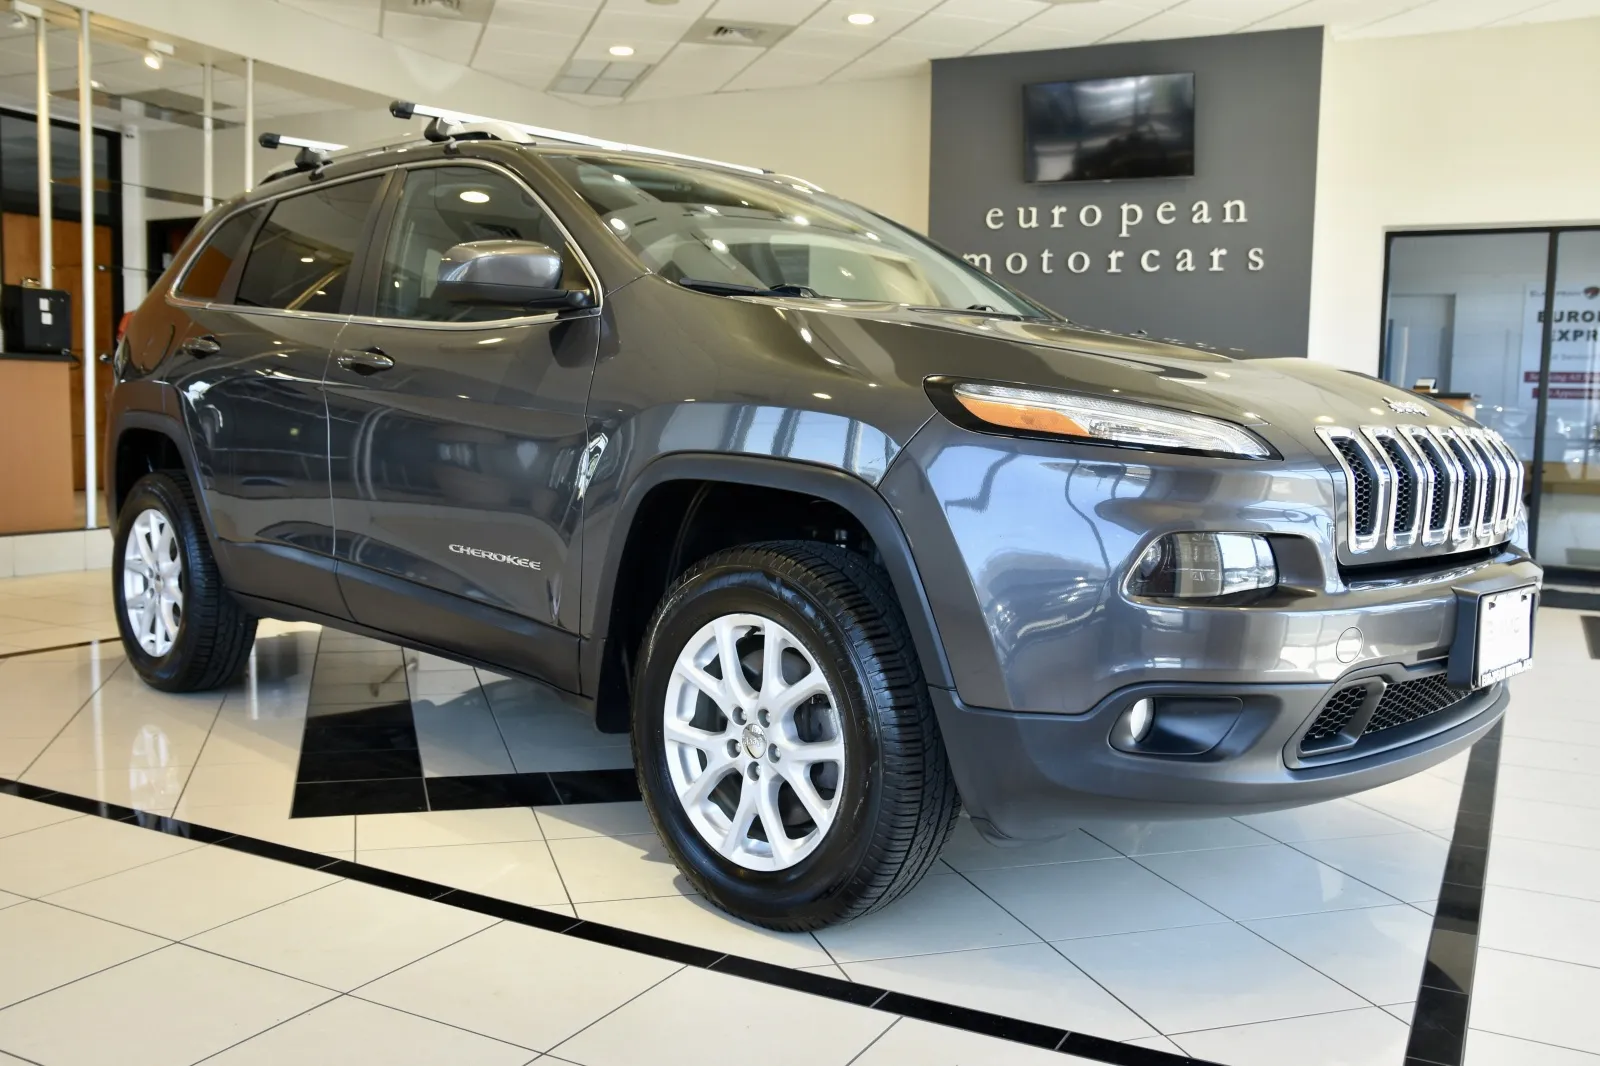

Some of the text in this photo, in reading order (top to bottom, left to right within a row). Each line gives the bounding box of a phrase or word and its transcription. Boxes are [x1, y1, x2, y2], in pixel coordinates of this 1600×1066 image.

[985, 199, 1249, 238] european
[963, 247, 1265, 275] motorcars
[1537, 310, 1600, 323] EURO
[448, 543, 542, 571] CHEROKEE
